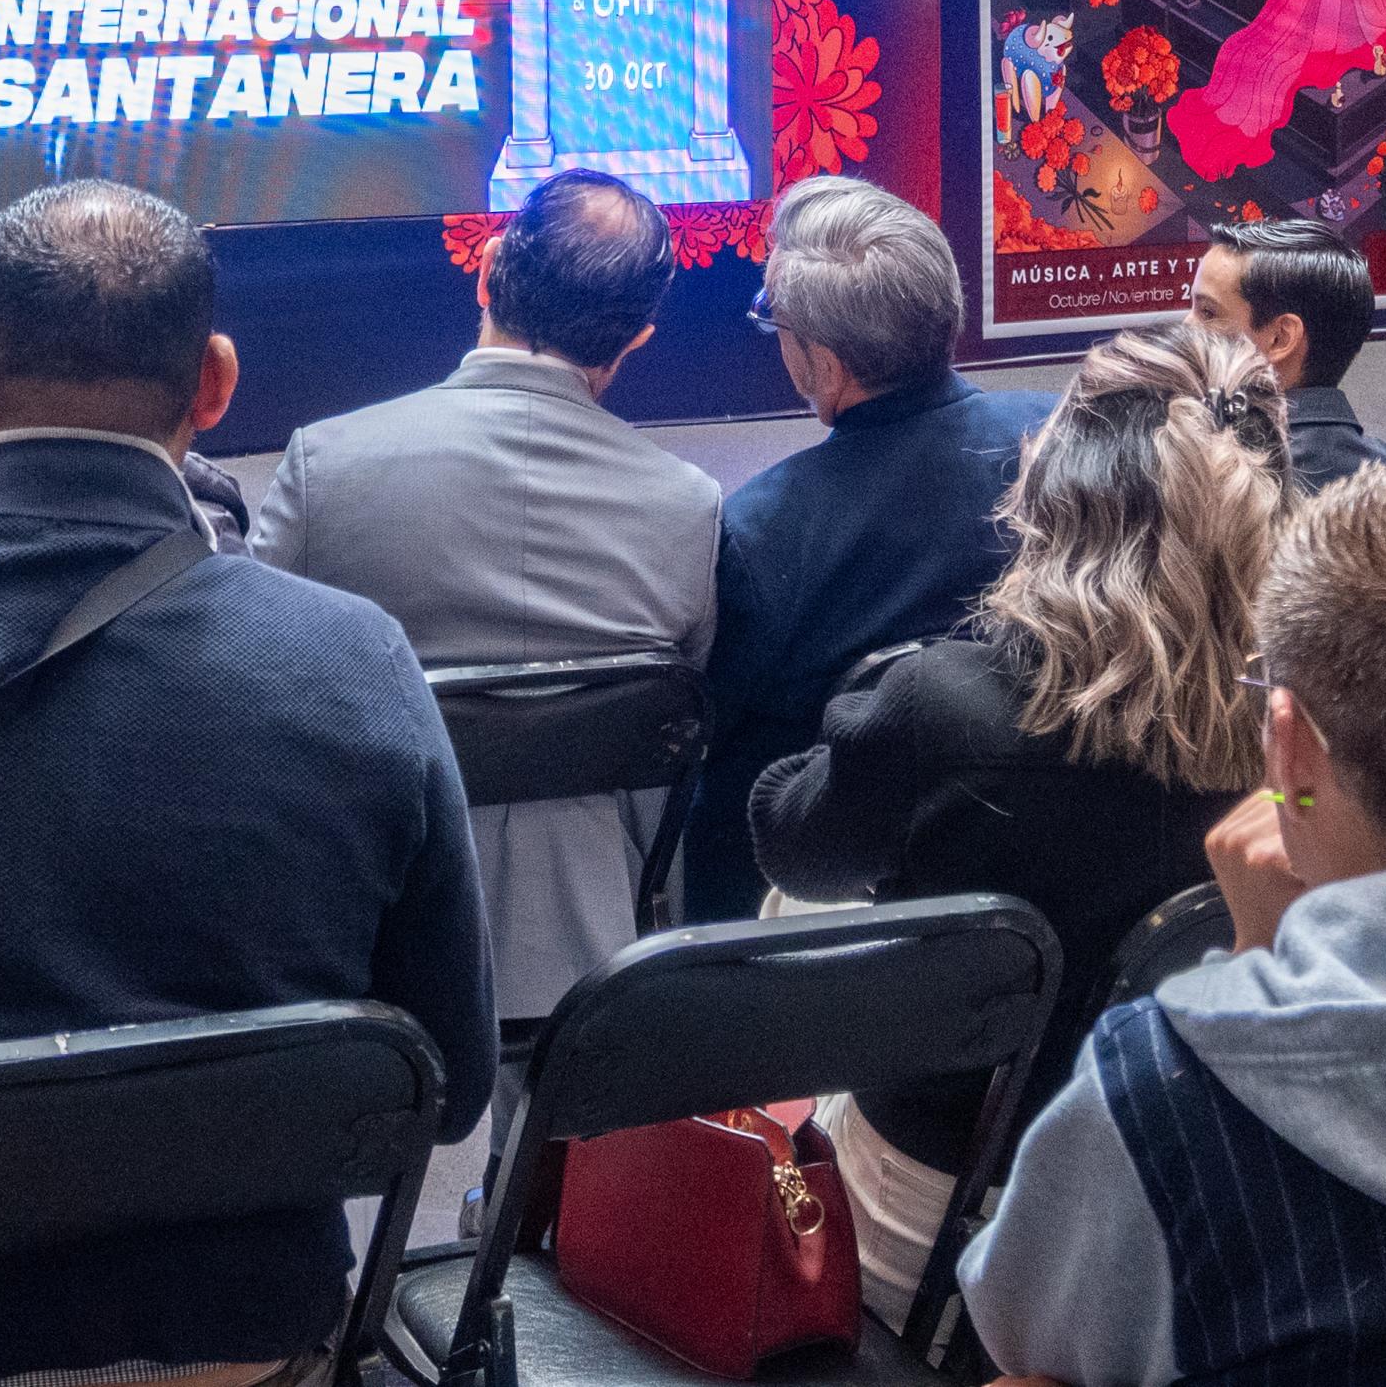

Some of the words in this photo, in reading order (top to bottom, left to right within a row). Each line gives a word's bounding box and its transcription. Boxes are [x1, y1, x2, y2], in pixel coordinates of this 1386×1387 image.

[584, 63, 614, 91] 30
[624, 63, 667, 91] OCT
[1112, 260, 1160, 278] ARTE
[1167, 258, 1178, 274] Y
